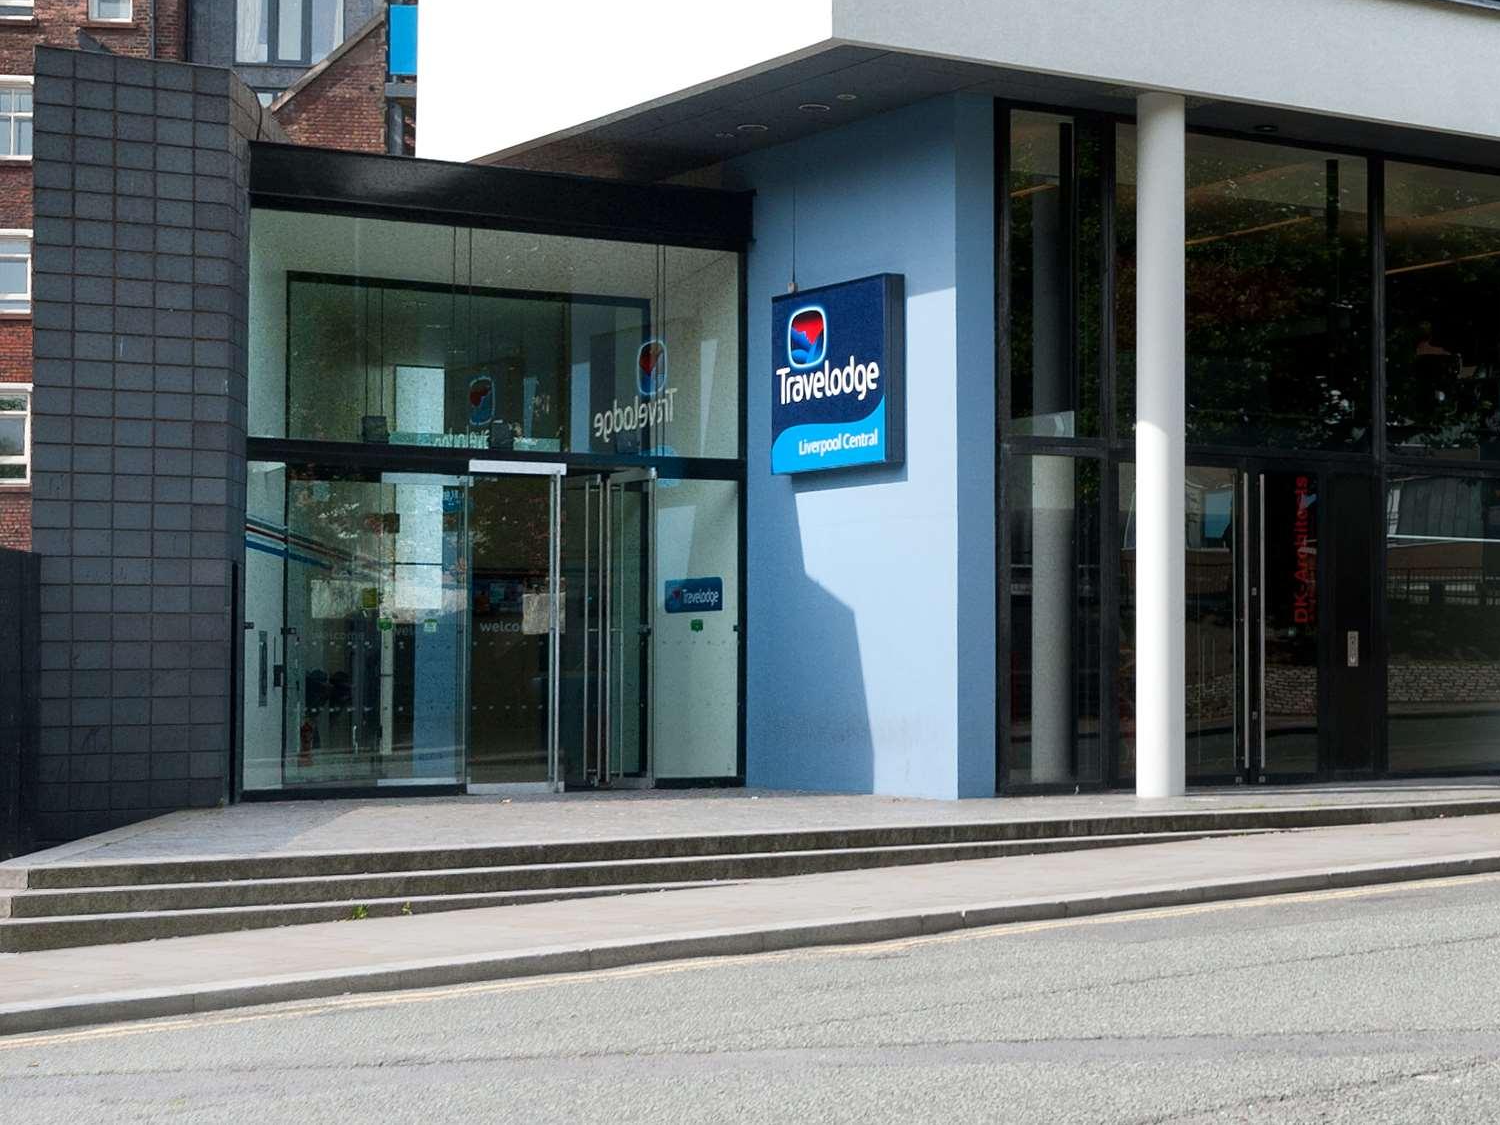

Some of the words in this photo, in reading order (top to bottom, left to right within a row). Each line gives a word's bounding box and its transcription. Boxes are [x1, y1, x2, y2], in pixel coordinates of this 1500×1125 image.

[776, 355, 880, 405] Travelodge
[798, 433, 842, 456] Liverpool
[843, 428, 878, 449] Central
[682, 588, 720, 607] Travelodge
[479, 620, 521, 633] welco
